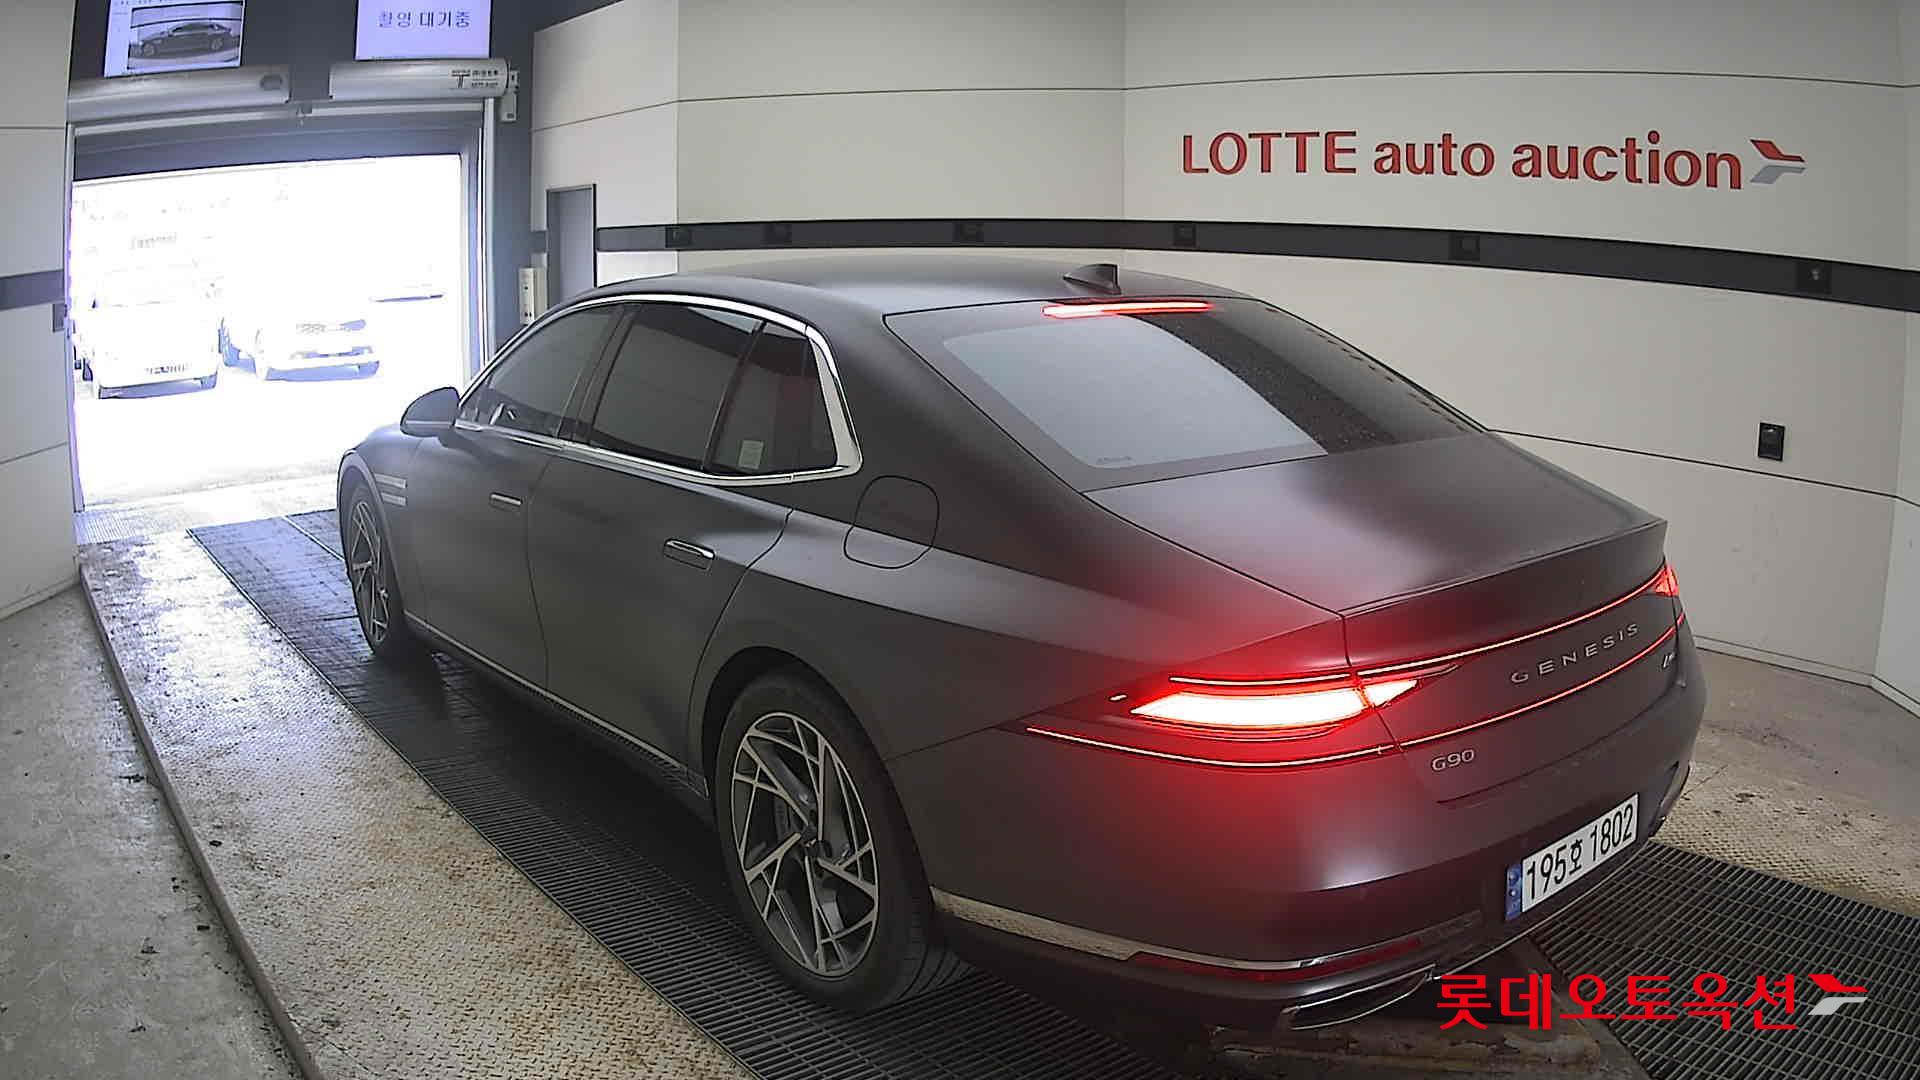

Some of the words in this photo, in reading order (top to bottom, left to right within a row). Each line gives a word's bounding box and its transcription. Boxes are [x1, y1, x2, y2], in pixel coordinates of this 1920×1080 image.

[419, 11, 471, 28] 대기중
[1183, 131, 1357, 174] LOTTE
[1374, 133, 1495, 176] auto
[1512, 131, 1742, 189] auction
[1510, 623, 1640, 684] GENESIS
[1431, 749, 1476, 772] G90
[1526, 839, 1583, 900] 195호
[1590, 804, 1634, 862] 1802
